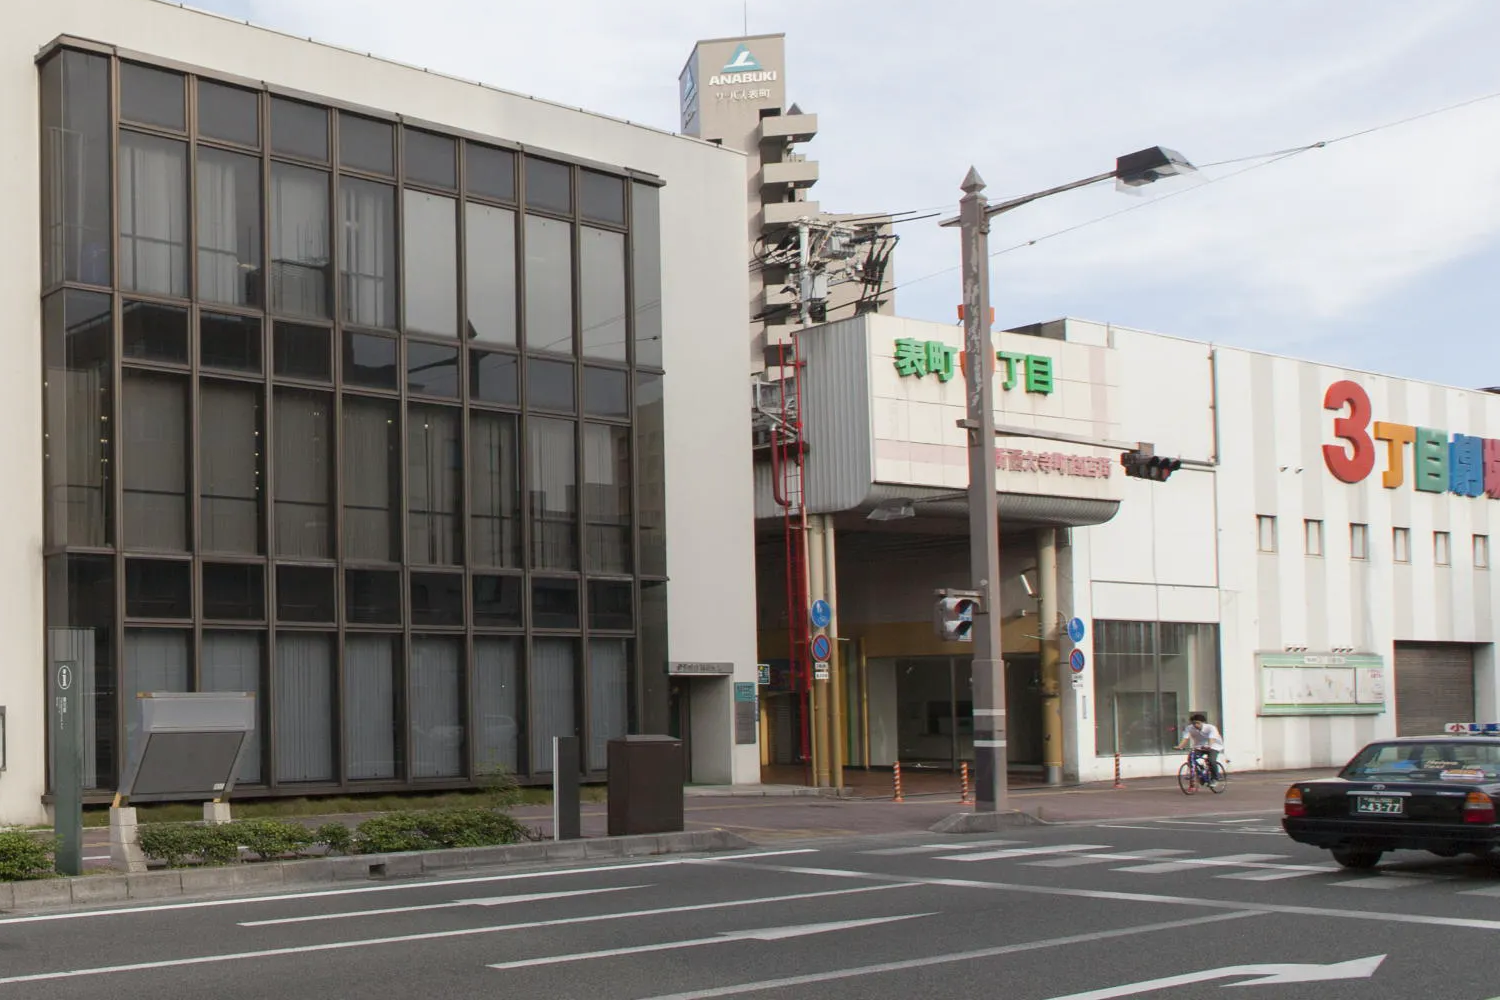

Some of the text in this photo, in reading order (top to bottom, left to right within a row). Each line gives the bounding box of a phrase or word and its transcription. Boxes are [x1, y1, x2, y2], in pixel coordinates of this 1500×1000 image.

[708, 70, 777, 86] ANABUKI
[893, 304, 1053, 396] 表町丁目
